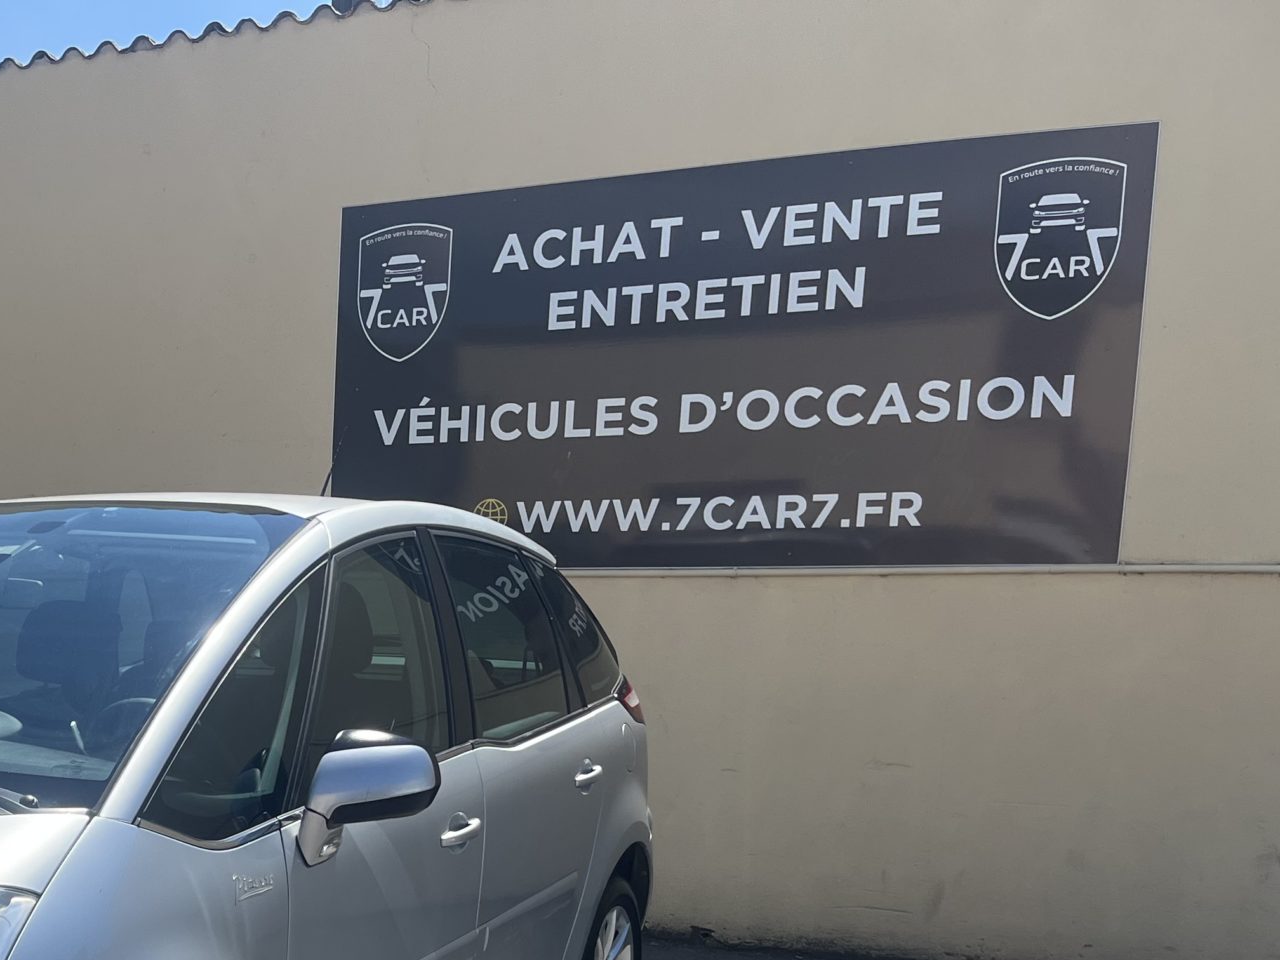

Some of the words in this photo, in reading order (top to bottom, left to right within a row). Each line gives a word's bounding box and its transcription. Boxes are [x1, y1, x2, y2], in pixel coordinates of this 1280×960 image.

[1008, 174, 1020, 183] En
[1020, 168, 1044, 180] route
[1045, 165, 1063, 174] vers
[1065, 164, 1073, 172] la
[1074, 164, 1113, 176] confiance
[492, 216, 685, 274] ACHAT
[741, 191, 944, 250] VENTE
[547, 266, 867, 331] ENTRETIEN
[373, 395, 659, 446] VÉHICULES
[678, 374, 1076, 434] D'OCCASION
[516, 491, 924, 534] WWW.7CAR7.FR
